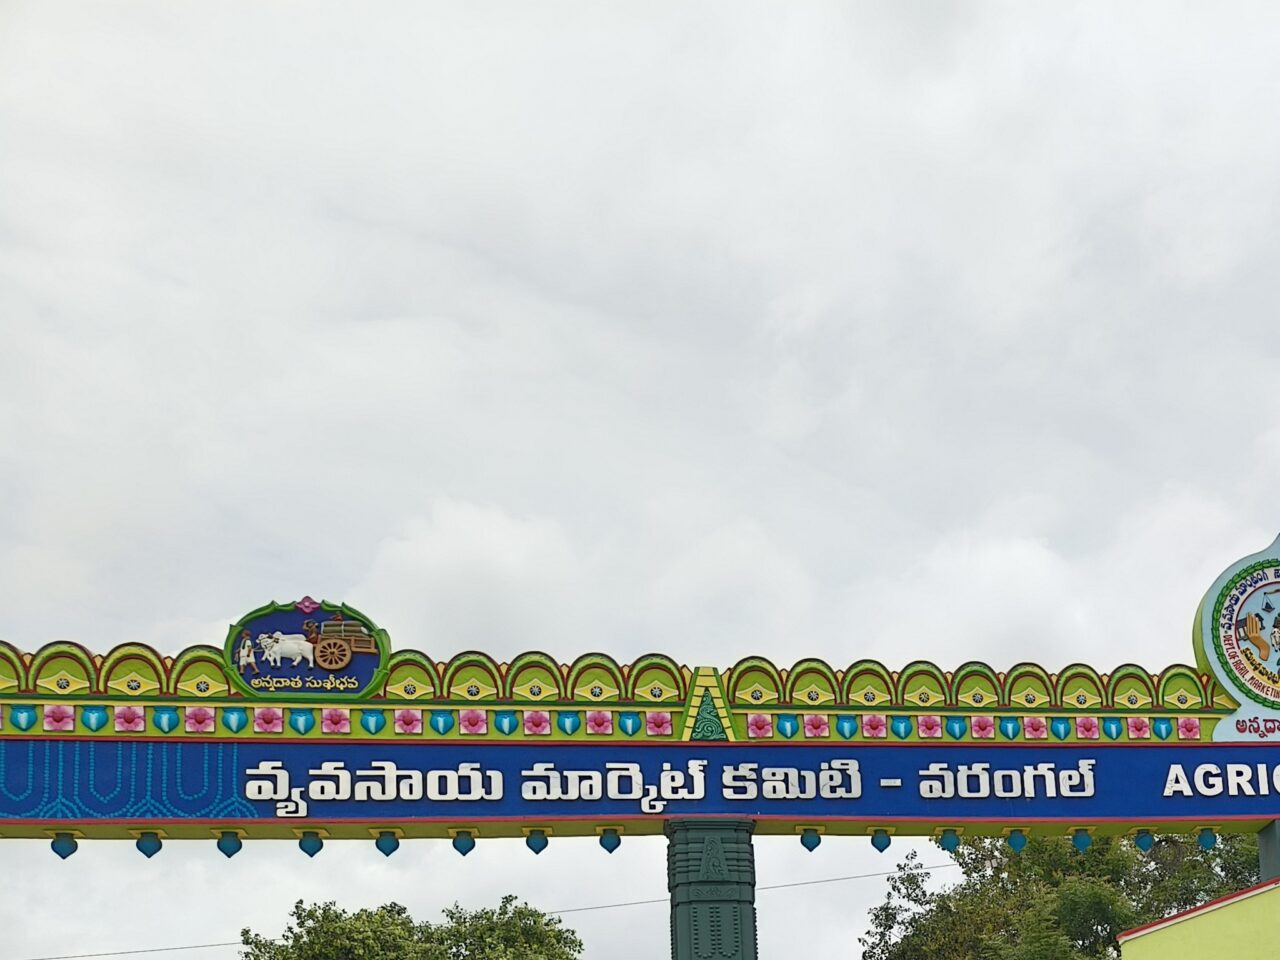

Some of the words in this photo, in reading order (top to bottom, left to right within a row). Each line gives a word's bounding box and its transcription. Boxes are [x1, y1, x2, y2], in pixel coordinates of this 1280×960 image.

[250, 674, 303, 692] అన్నదాత
[245, 761, 504, 817] వ్యవసాయ
[521, 759, 708, 813] మార్కెట్
[918, 759, 1096, 798] వరంగల్
